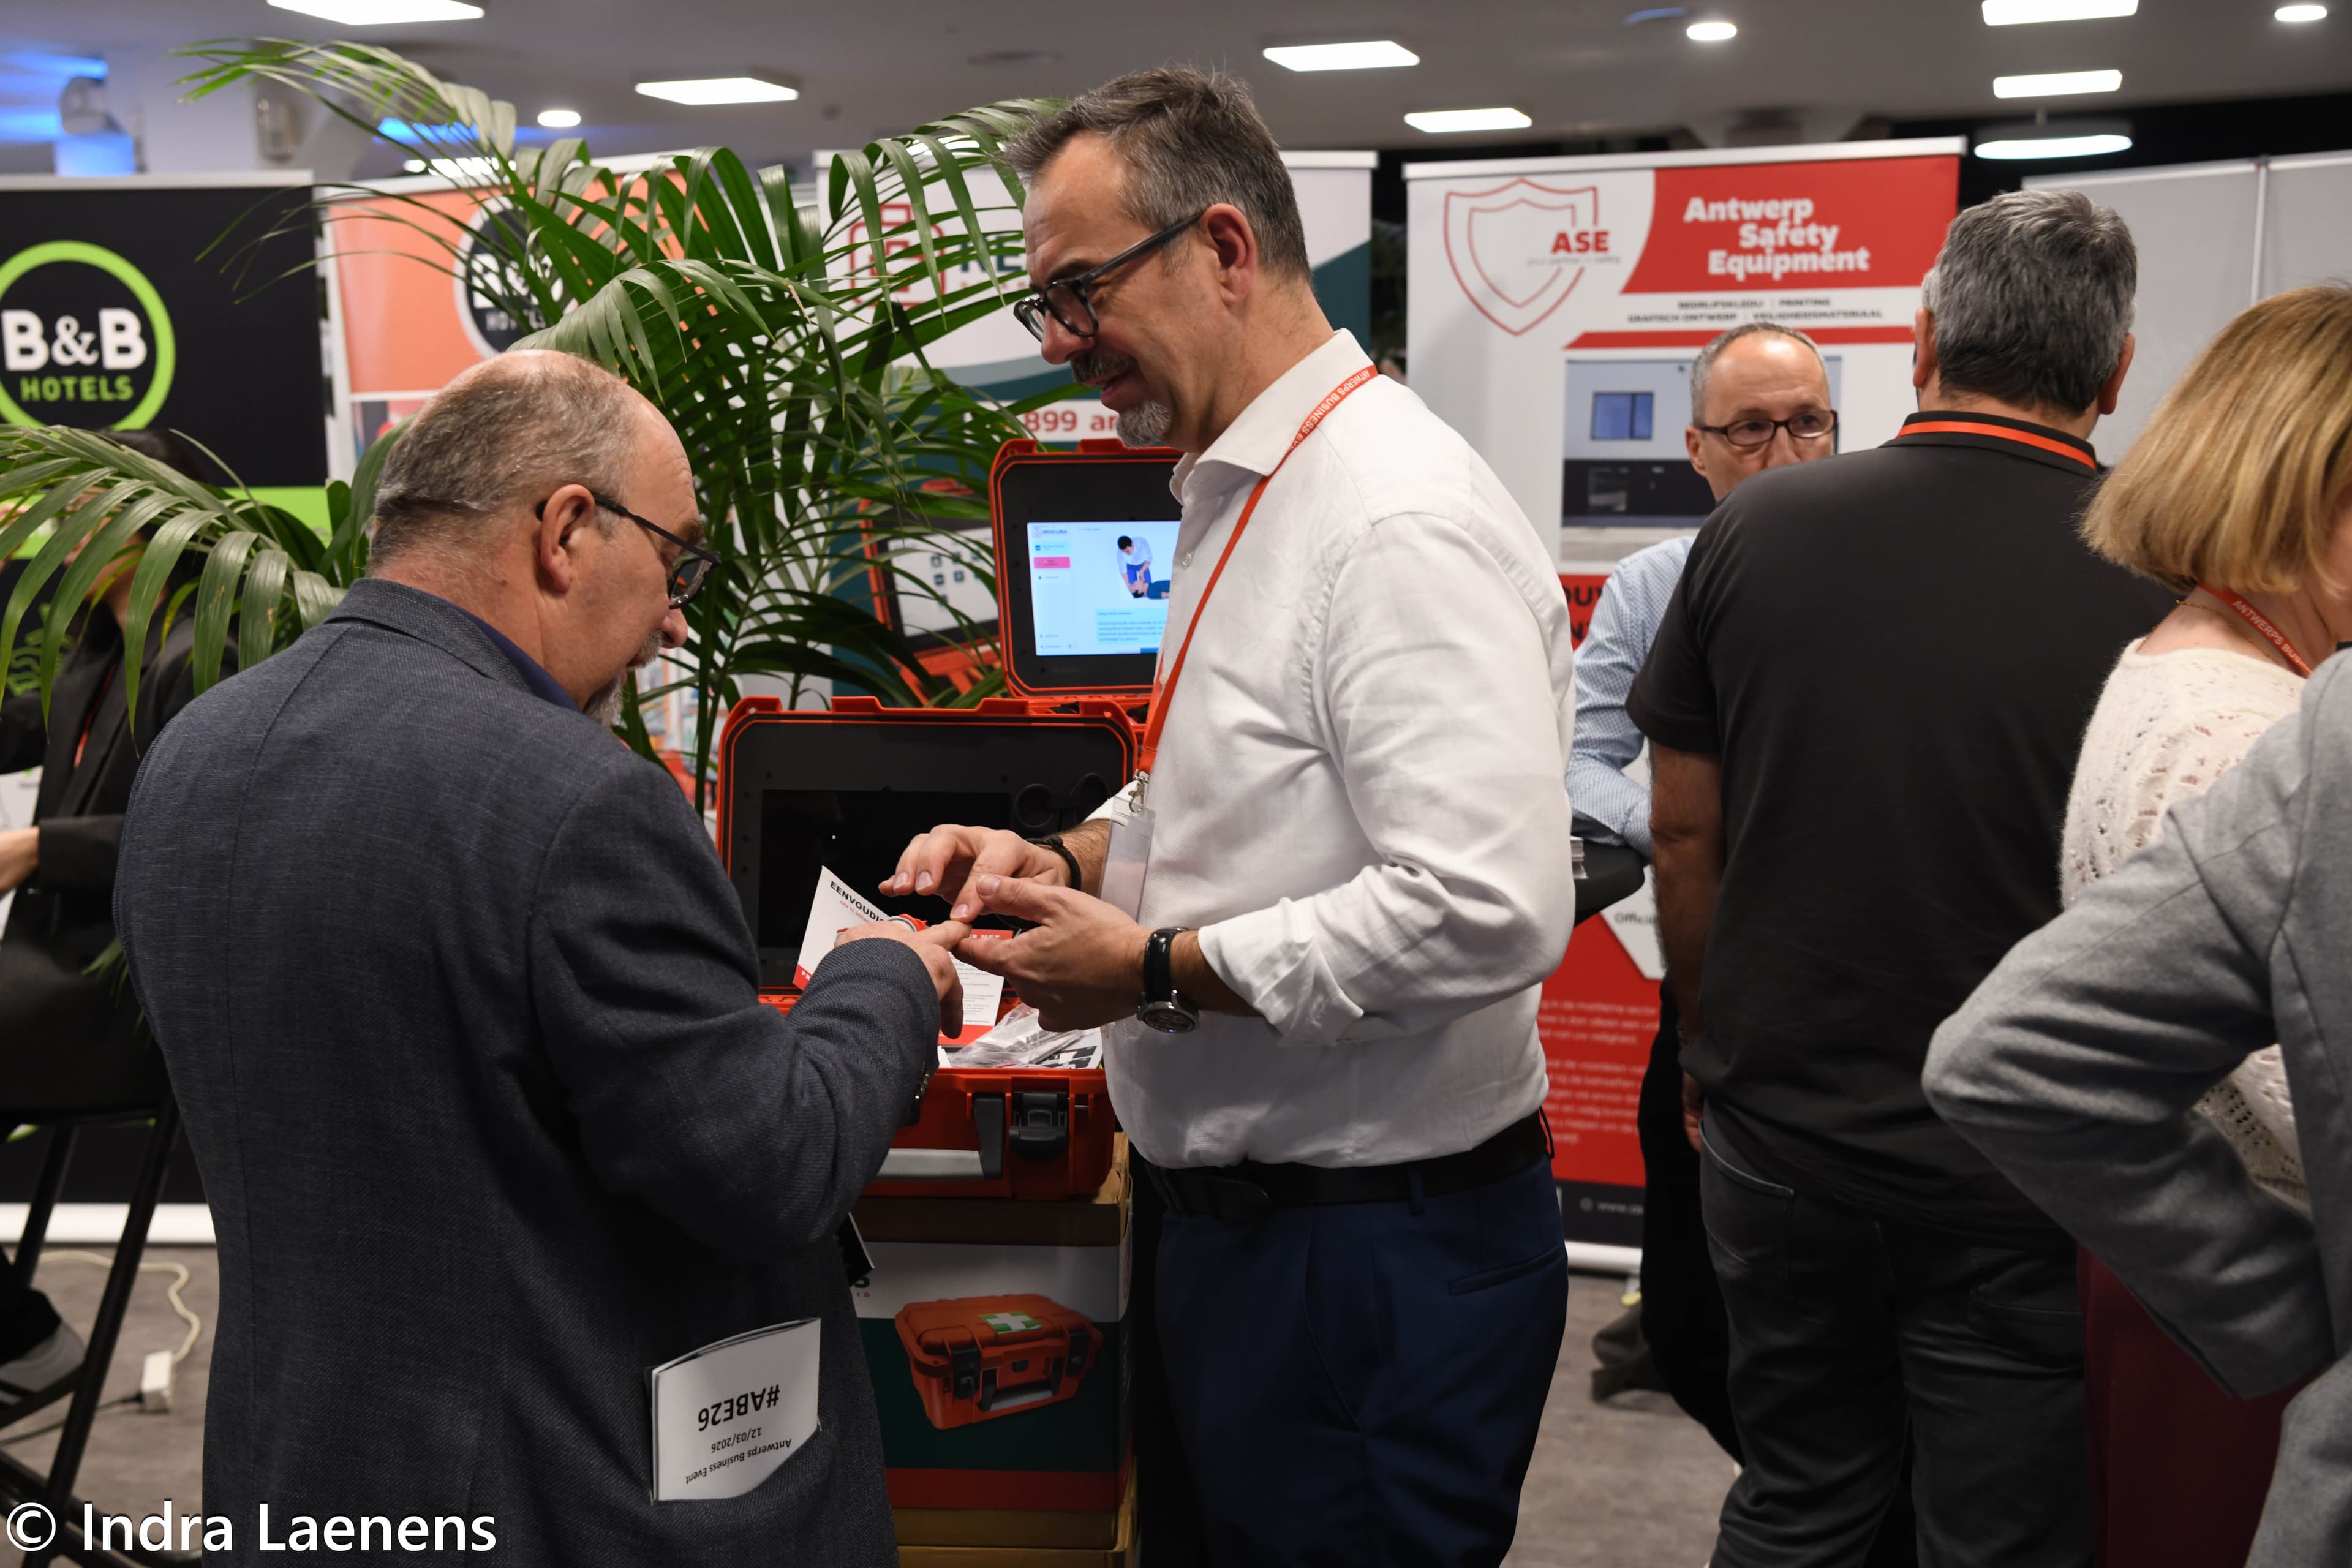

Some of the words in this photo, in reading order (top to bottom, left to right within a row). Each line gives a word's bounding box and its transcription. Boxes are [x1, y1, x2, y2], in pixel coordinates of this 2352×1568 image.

[1684, 197, 1814, 225] Antwerp
[1551, 230, 1609, 254] ASE
[1739, 219, 1839, 253] Safety
[1708, 246, 1870, 282] Equipment
[1778, 298, 1831, 306] PRINTING
[1627, 313, 1679, 323] GRAFISCH
[1683, 312, 1736, 322] ONTWERP
[1752, 309, 1883, 320] VEILIGHEIDSMATERIAAL
[2, 308, 146, 370] B&B
[20, 375, 134, 401] HOTELS
[1337, 369, 1371, 396] ANTWERPS
[1024, 410, 1077, 432] 899
[1301, 392, 1340, 434] BUSINESS
[2232, 600, 2284, 645] ANTWERPS
[830, 881, 884, 922] EENVOUDI
[698, 1384, 780, 1432] #ABE26
[711, 1427, 763, 1453] 12/03/2026
[747, 1438, 792, 1458] Antwerps
[709, 1452, 745, 1473] Business
[685, 1467, 707, 1485] Event
